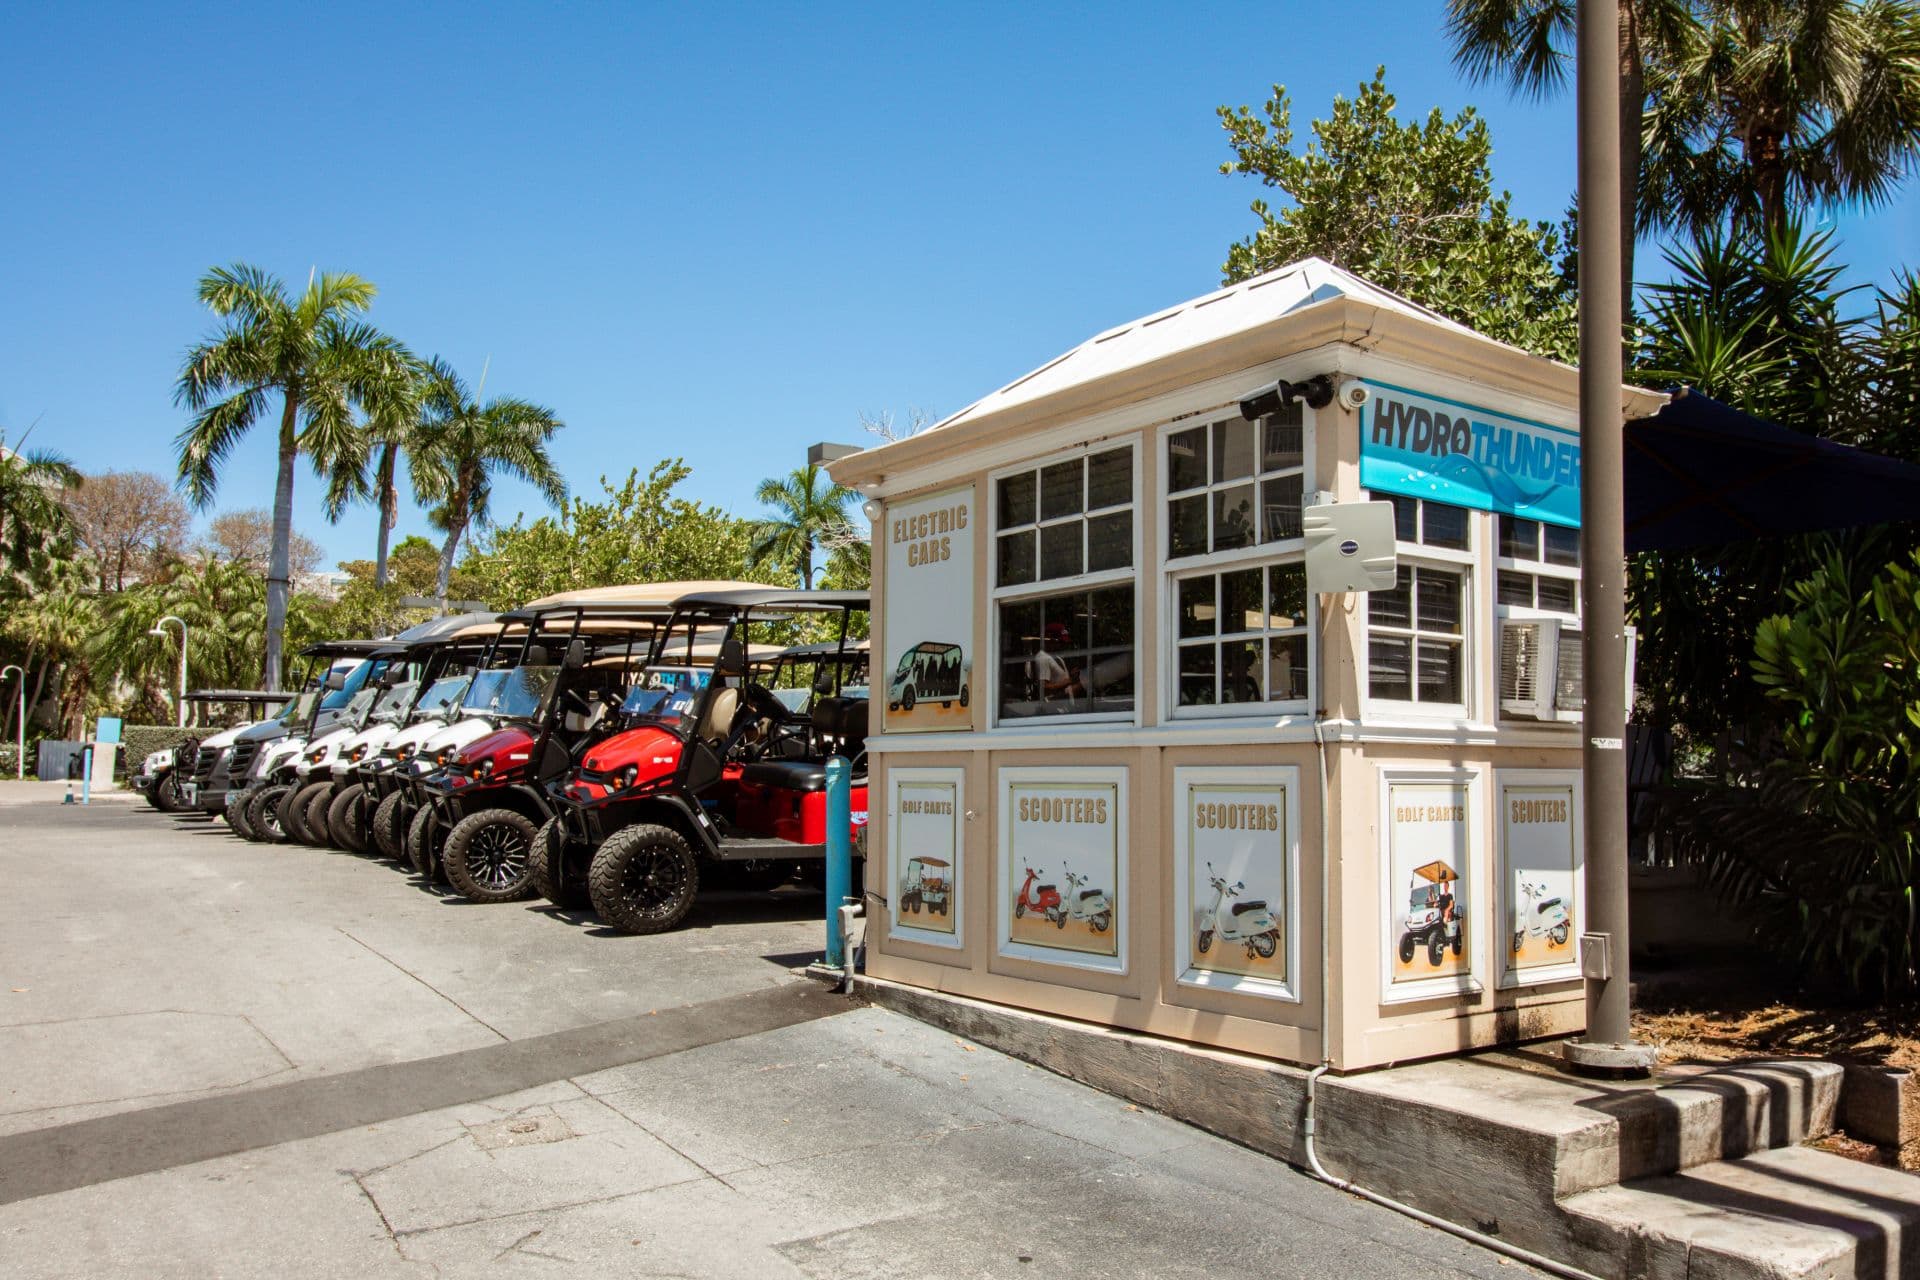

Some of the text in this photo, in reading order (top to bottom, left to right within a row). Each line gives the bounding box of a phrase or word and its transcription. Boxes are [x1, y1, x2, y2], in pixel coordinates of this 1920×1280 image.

[893, 504, 968, 544] ELECTRIC
[908, 536, 951, 567] CARS
[902, 800, 952, 815] GOLF CARTS
[1019, 797, 1107, 824] SCOOTERS
[1196, 803, 1278, 831] SCOOTERS
[1396, 805, 1464, 823] GOLF CARTS
[1511, 799, 1567, 824] SCOOTERS
